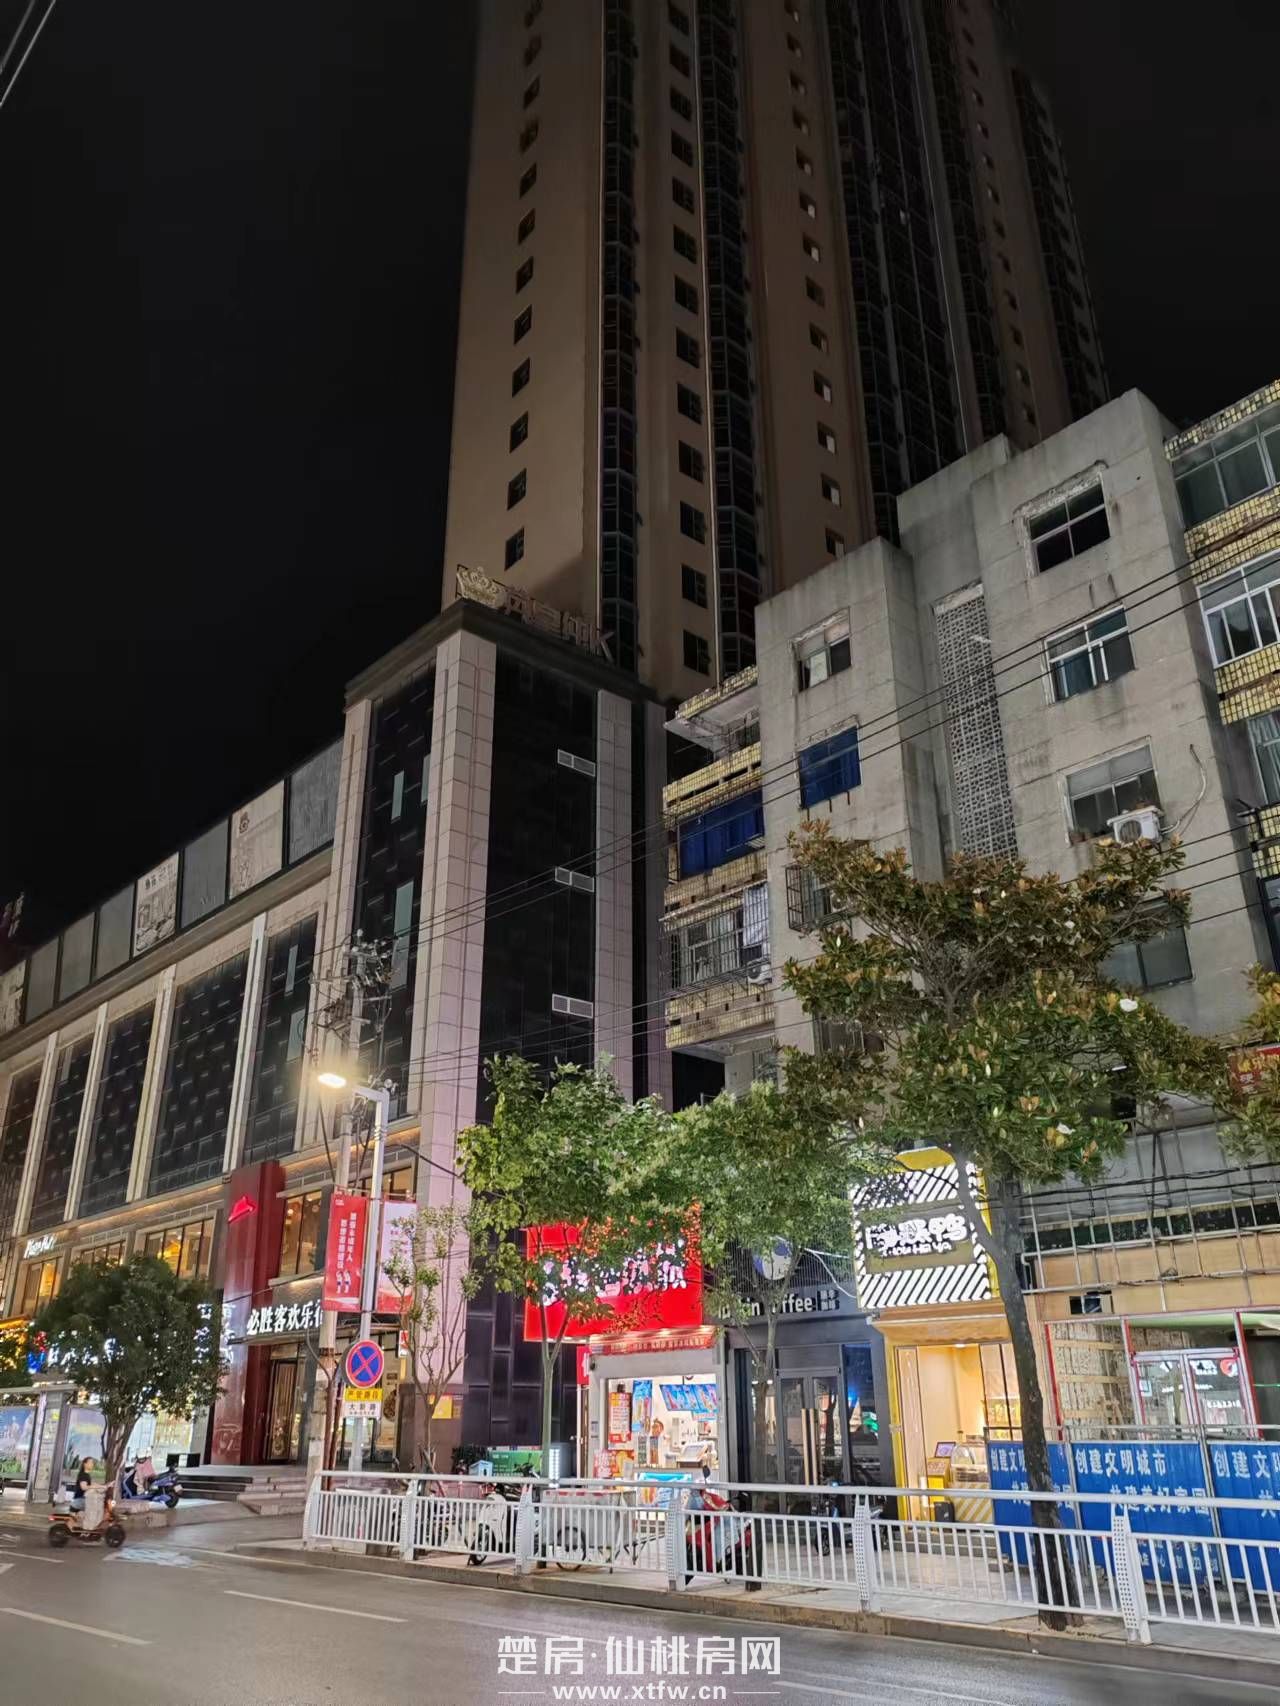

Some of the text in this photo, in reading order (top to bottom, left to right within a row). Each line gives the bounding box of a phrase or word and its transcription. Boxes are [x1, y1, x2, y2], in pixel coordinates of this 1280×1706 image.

[1075, 1448, 1167, 1477] 创建文明城市
